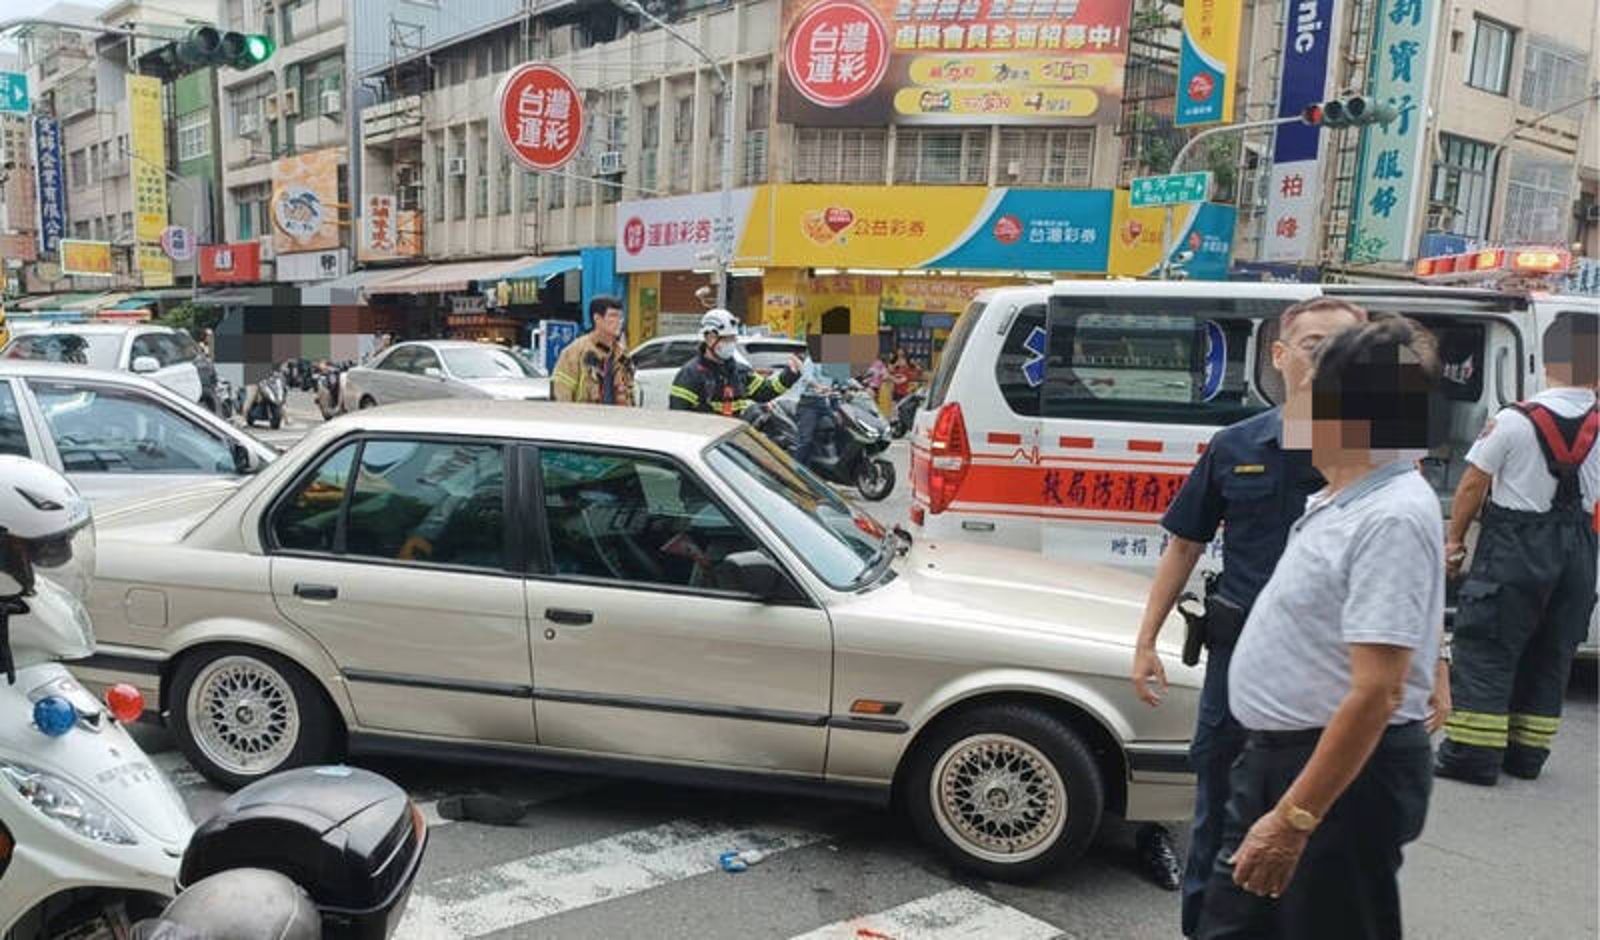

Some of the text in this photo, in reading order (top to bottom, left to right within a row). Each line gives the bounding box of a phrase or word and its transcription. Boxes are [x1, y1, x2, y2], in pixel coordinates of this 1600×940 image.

[809, 22, 869, 52] 台灣
[806, 54, 867, 84] 運彩
[518, 83, 571, 119] 台灣
[515, 117, 570, 151] 運彩
[648, 217, 712, 246] 運動彩券
[854, 218, 925, 238] 公益彩券
[1029, 227, 1097, 243] 台灣彩券
